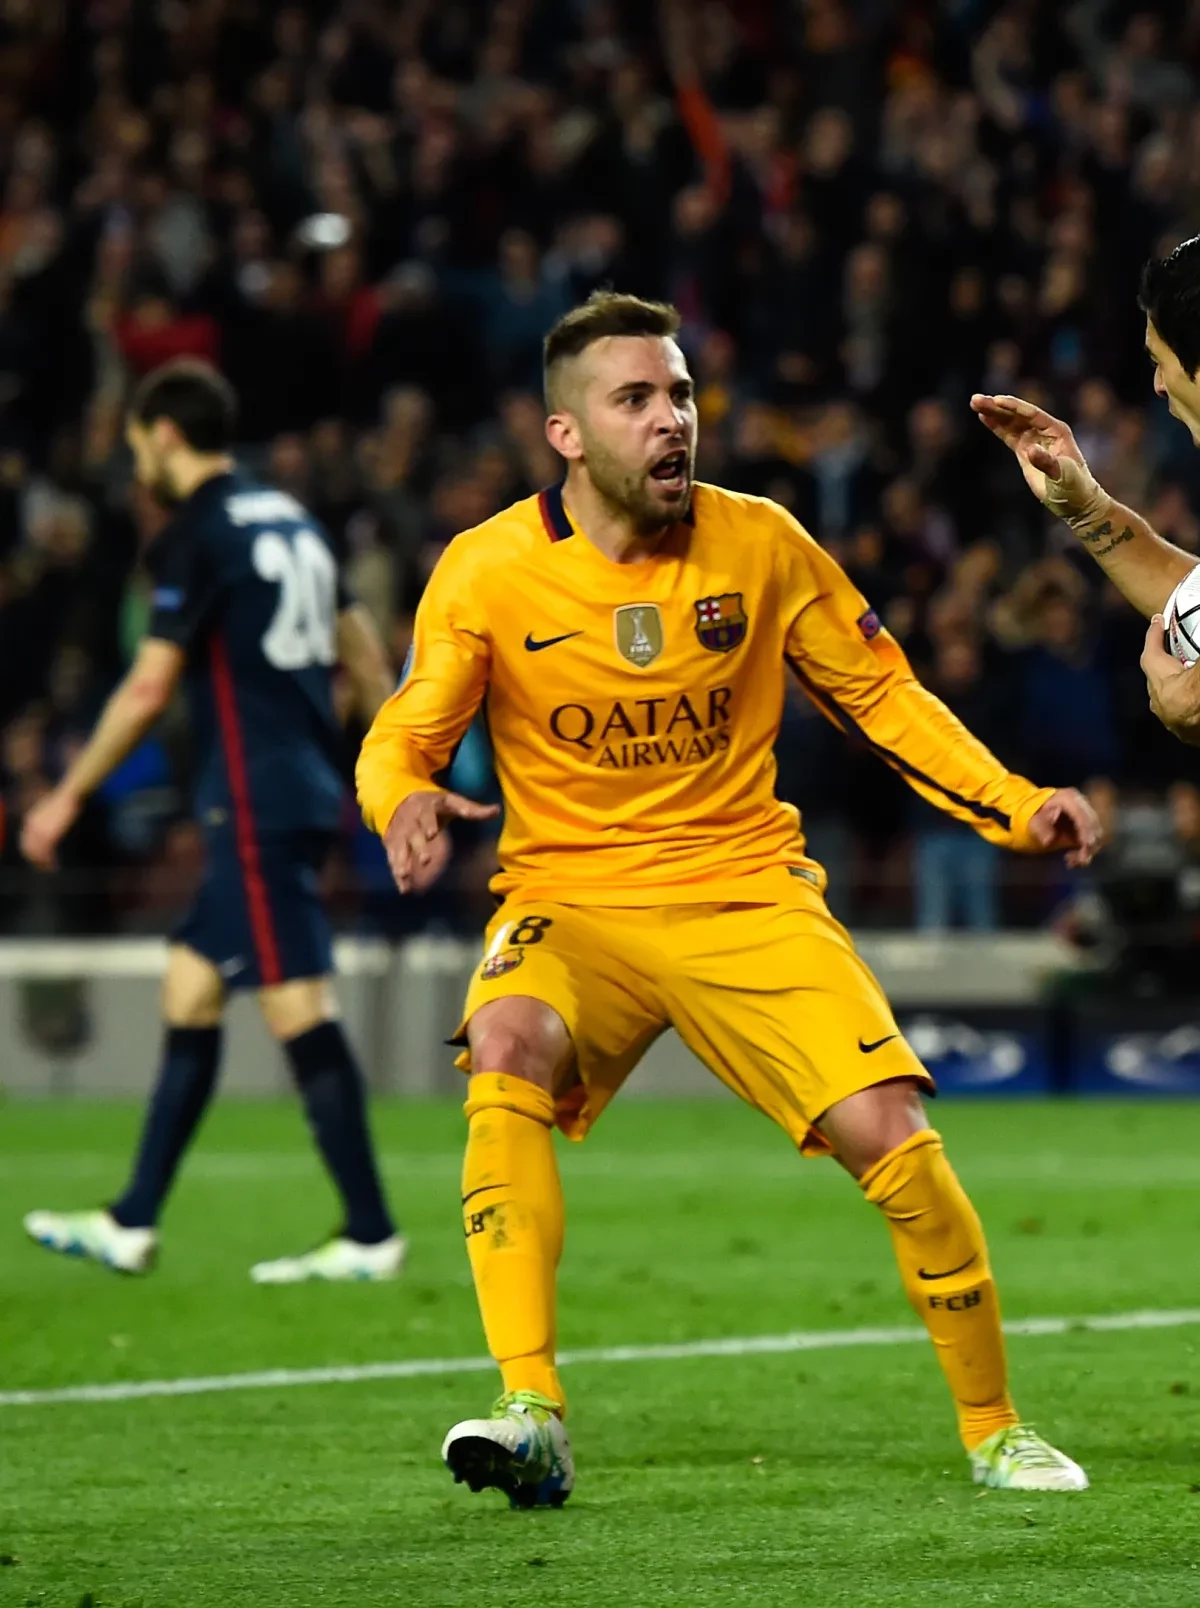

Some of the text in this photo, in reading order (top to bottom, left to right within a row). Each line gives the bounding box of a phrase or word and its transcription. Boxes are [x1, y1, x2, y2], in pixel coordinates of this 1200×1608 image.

[252, 529, 338, 671] 20
[549, 686, 732, 749] QATAR
[597, 724, 730, 768] AIRWAYS
[929, 1289, 981, 1311] FCB
